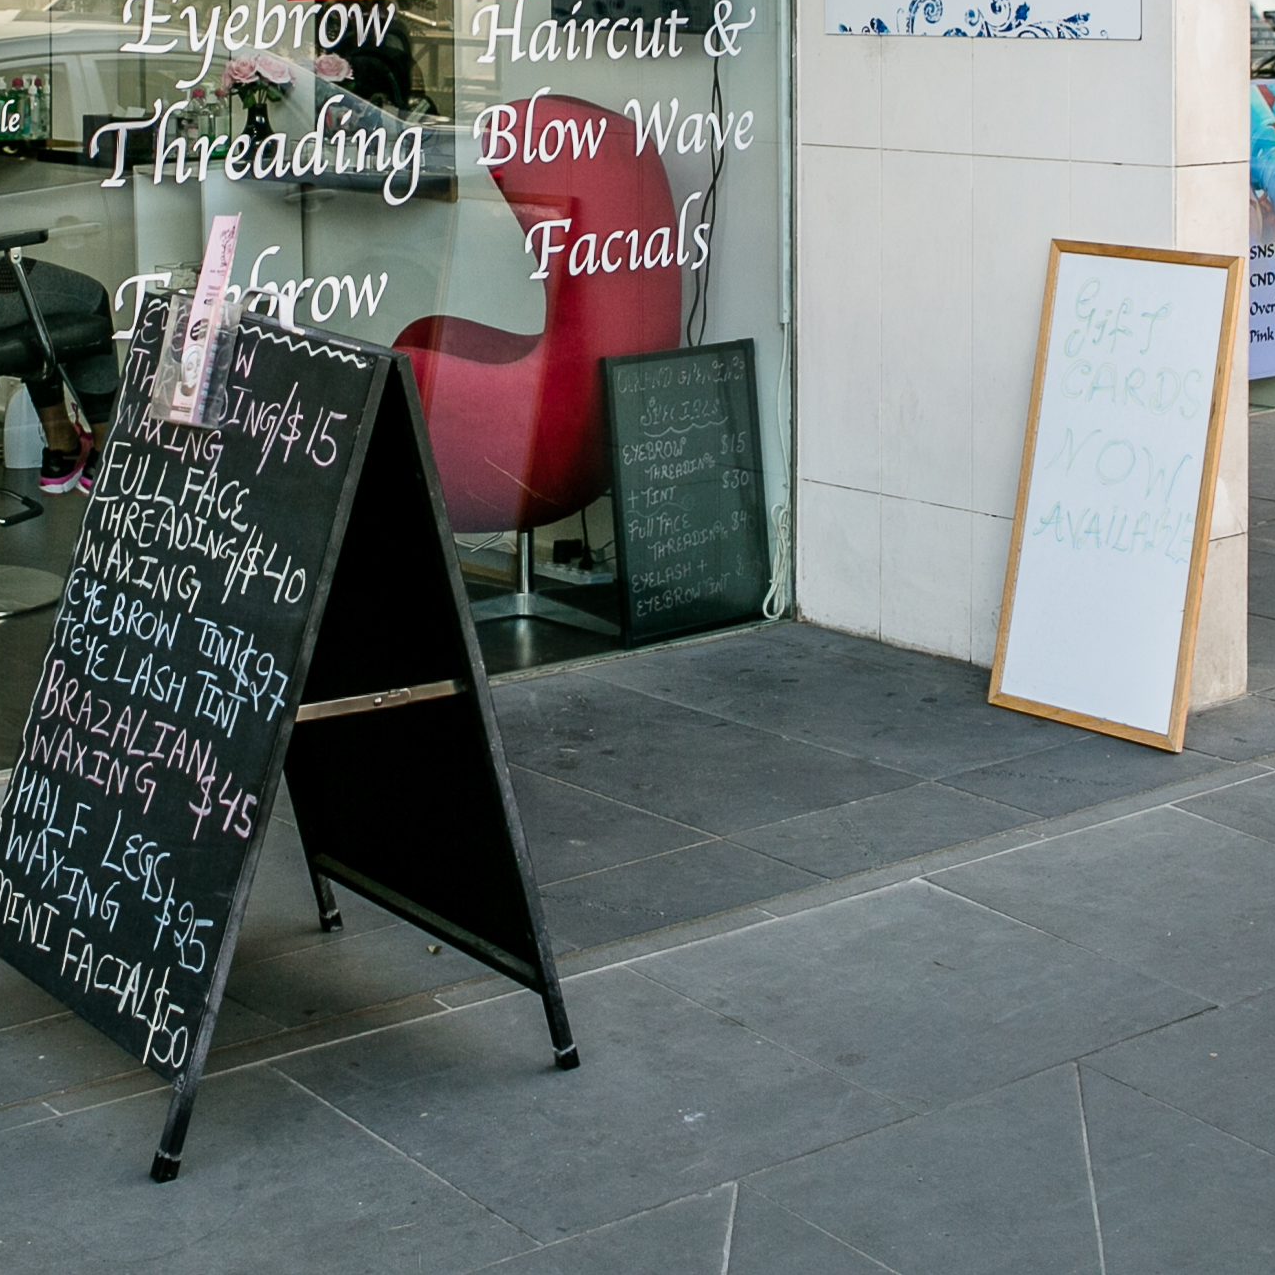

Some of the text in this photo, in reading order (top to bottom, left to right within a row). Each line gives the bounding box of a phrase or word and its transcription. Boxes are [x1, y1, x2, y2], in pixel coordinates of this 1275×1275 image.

[90, 94, 424, 207] Threading
[472, 86, 755, 167] Blow Wave
[524, 191, 711, 282] Facials
[1250, 243, 1274, 260] SNS
[1250, 272, 1275, 287] CND
[1250, 327, 1274, 343] Pink
[1060, 360, 1205, 422] CARDS
[101, 442, 250, 532] FULL FACE
[1044, 426, 1194, 501] NOW
[68, 568, 181, 649] EYEBROW
[82, 530, 201, 612] WAXING
[30, 725, 258, 839] WAXING $45
[13, 766, 171, 901] HALF LEGS
[5, 819, 121, 931] WAXING
[60, 928, 154, 1019] FACIAL
